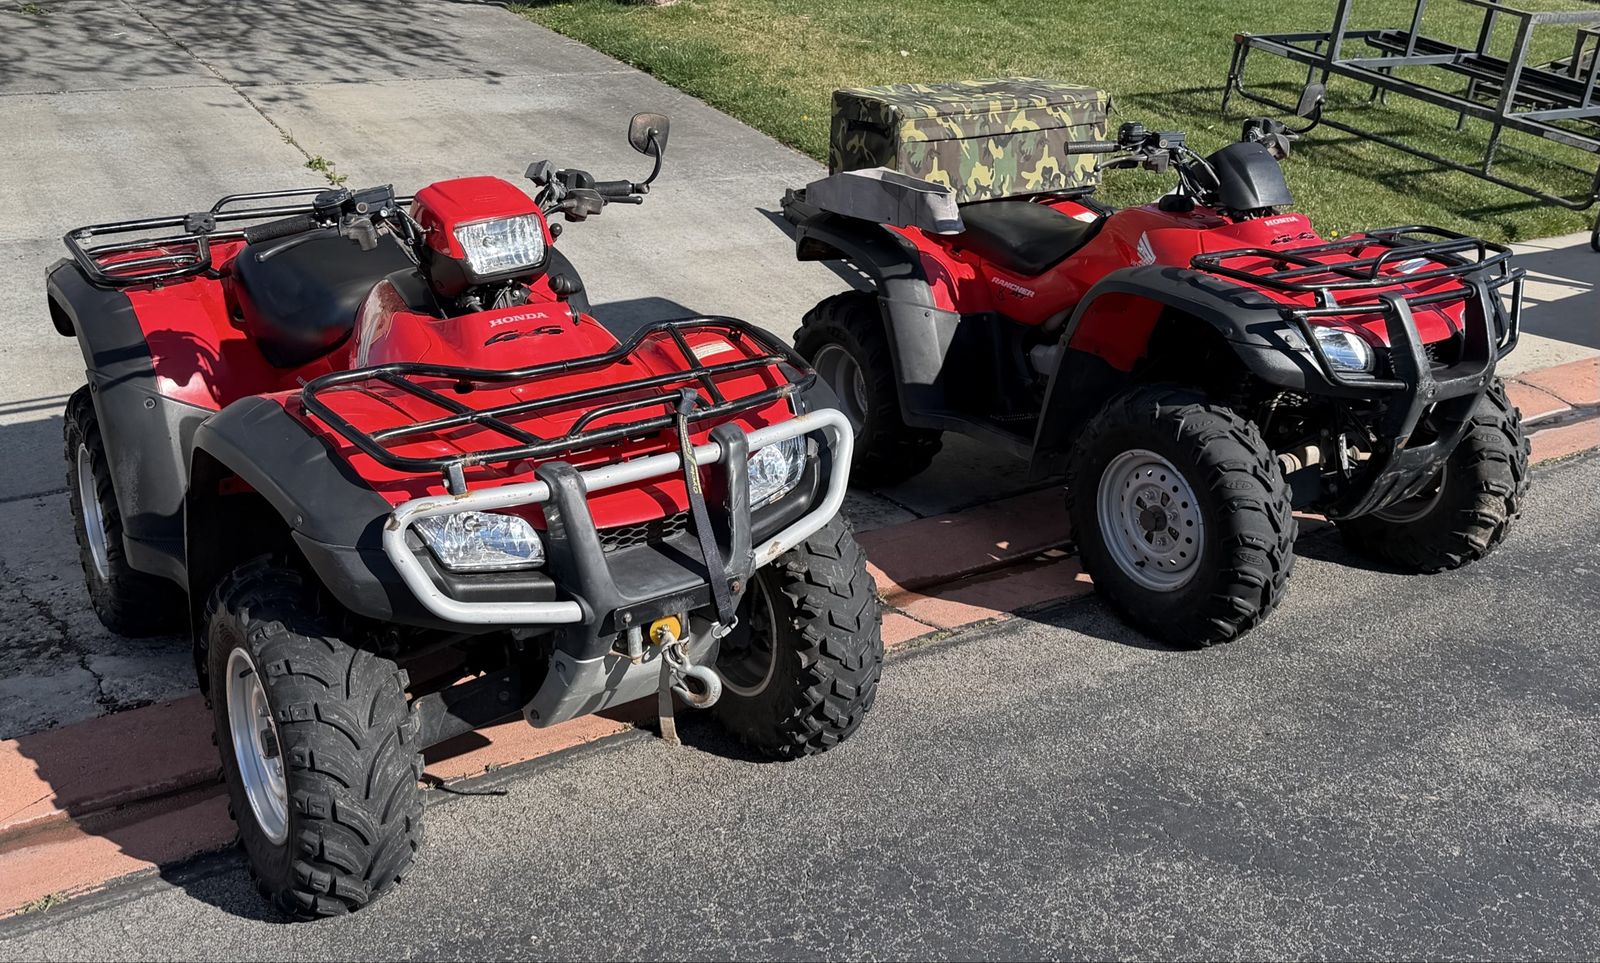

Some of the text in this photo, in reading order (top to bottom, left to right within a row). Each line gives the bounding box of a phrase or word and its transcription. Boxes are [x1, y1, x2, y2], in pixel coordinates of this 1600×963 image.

[1264, 216, 1298, 227] HONDA
[991, 276, 1035, 298] RANCHER
[489, 312, 548, 328] HONDA
